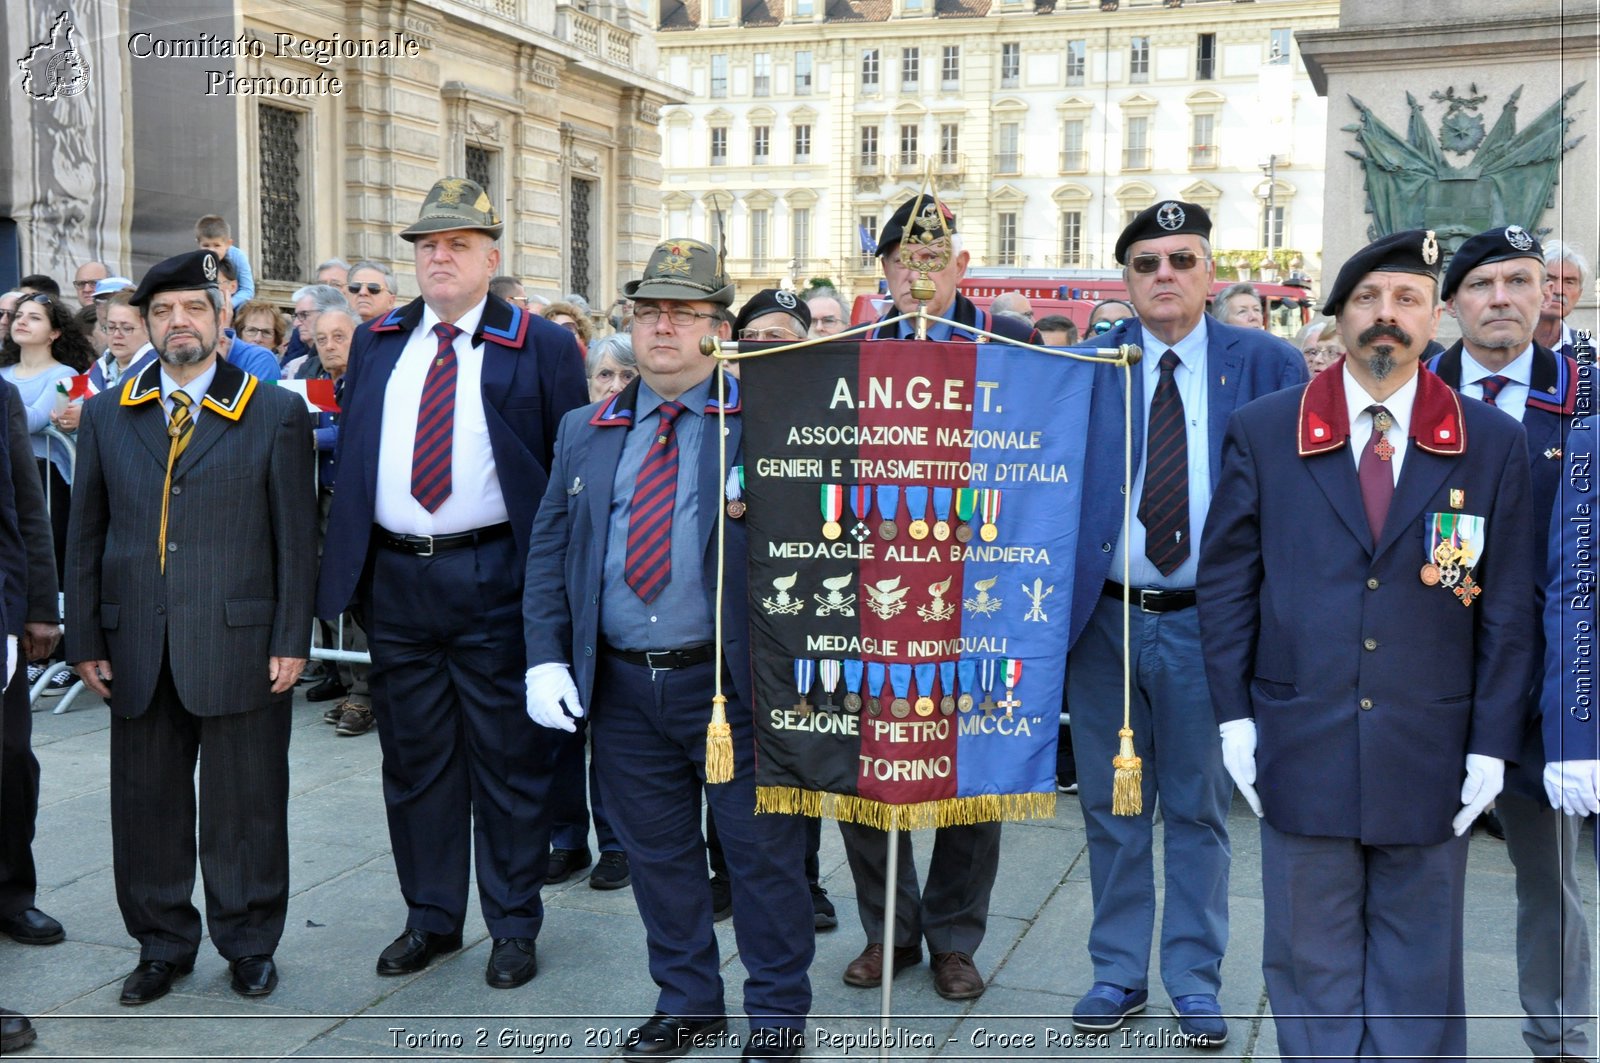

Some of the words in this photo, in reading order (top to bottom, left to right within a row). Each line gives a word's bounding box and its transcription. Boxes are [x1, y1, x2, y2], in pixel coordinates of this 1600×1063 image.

[1052, 290, 1100, 299] FCO
[829, 376, 1003, 414] A.N.G.E.T.
[786, 426, 929, 447] ASSOCIAZIONE
[936, 427, 1043, 450] NAZIONALE
[756, 458, 823, 479] GENIERI
[831, 459, 843, 478] E
[850, 459, 988, 482] TRASMETTITORI
[995, 463, 1069, 484] D'ITALIA
[768, 541, 876, 560] MEDAGLIE
[884, 545, 942, 563] ALLA
[949, 545, 1051, 565] BANDIERA
[806, 635, 898, 657] MEDAGLIE
[907, 637, 1008, 658] INDIVIDUALI
[770, 708, 860, 736] SEZIONE
[868, 718, 950, 743] "PIETRO
[958, 716, 1042, 738] MICCA"
[858, 755, 952, 782] TORINO
